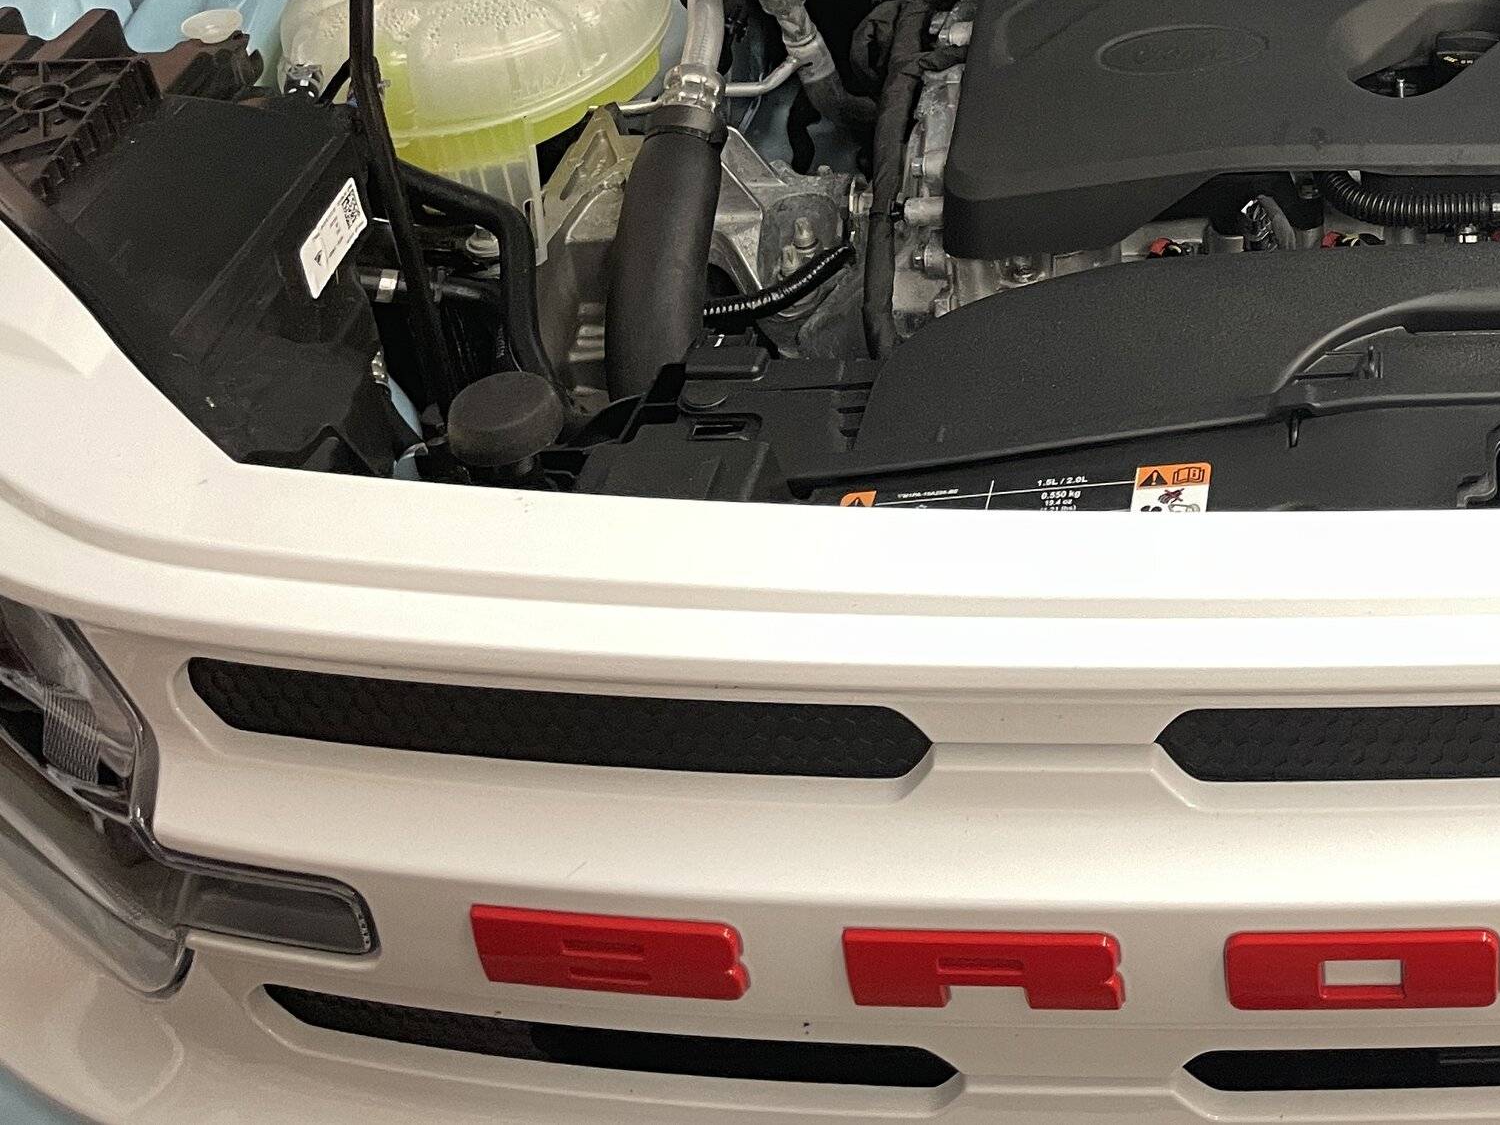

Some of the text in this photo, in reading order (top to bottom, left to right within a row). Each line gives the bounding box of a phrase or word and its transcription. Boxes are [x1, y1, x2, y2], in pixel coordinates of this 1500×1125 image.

[1037, 478, 1058, 487] 1.5L
[1066, 476, 1088, 485] 2.0L
[1041, 490, 1081, 500] 0.550 kg
